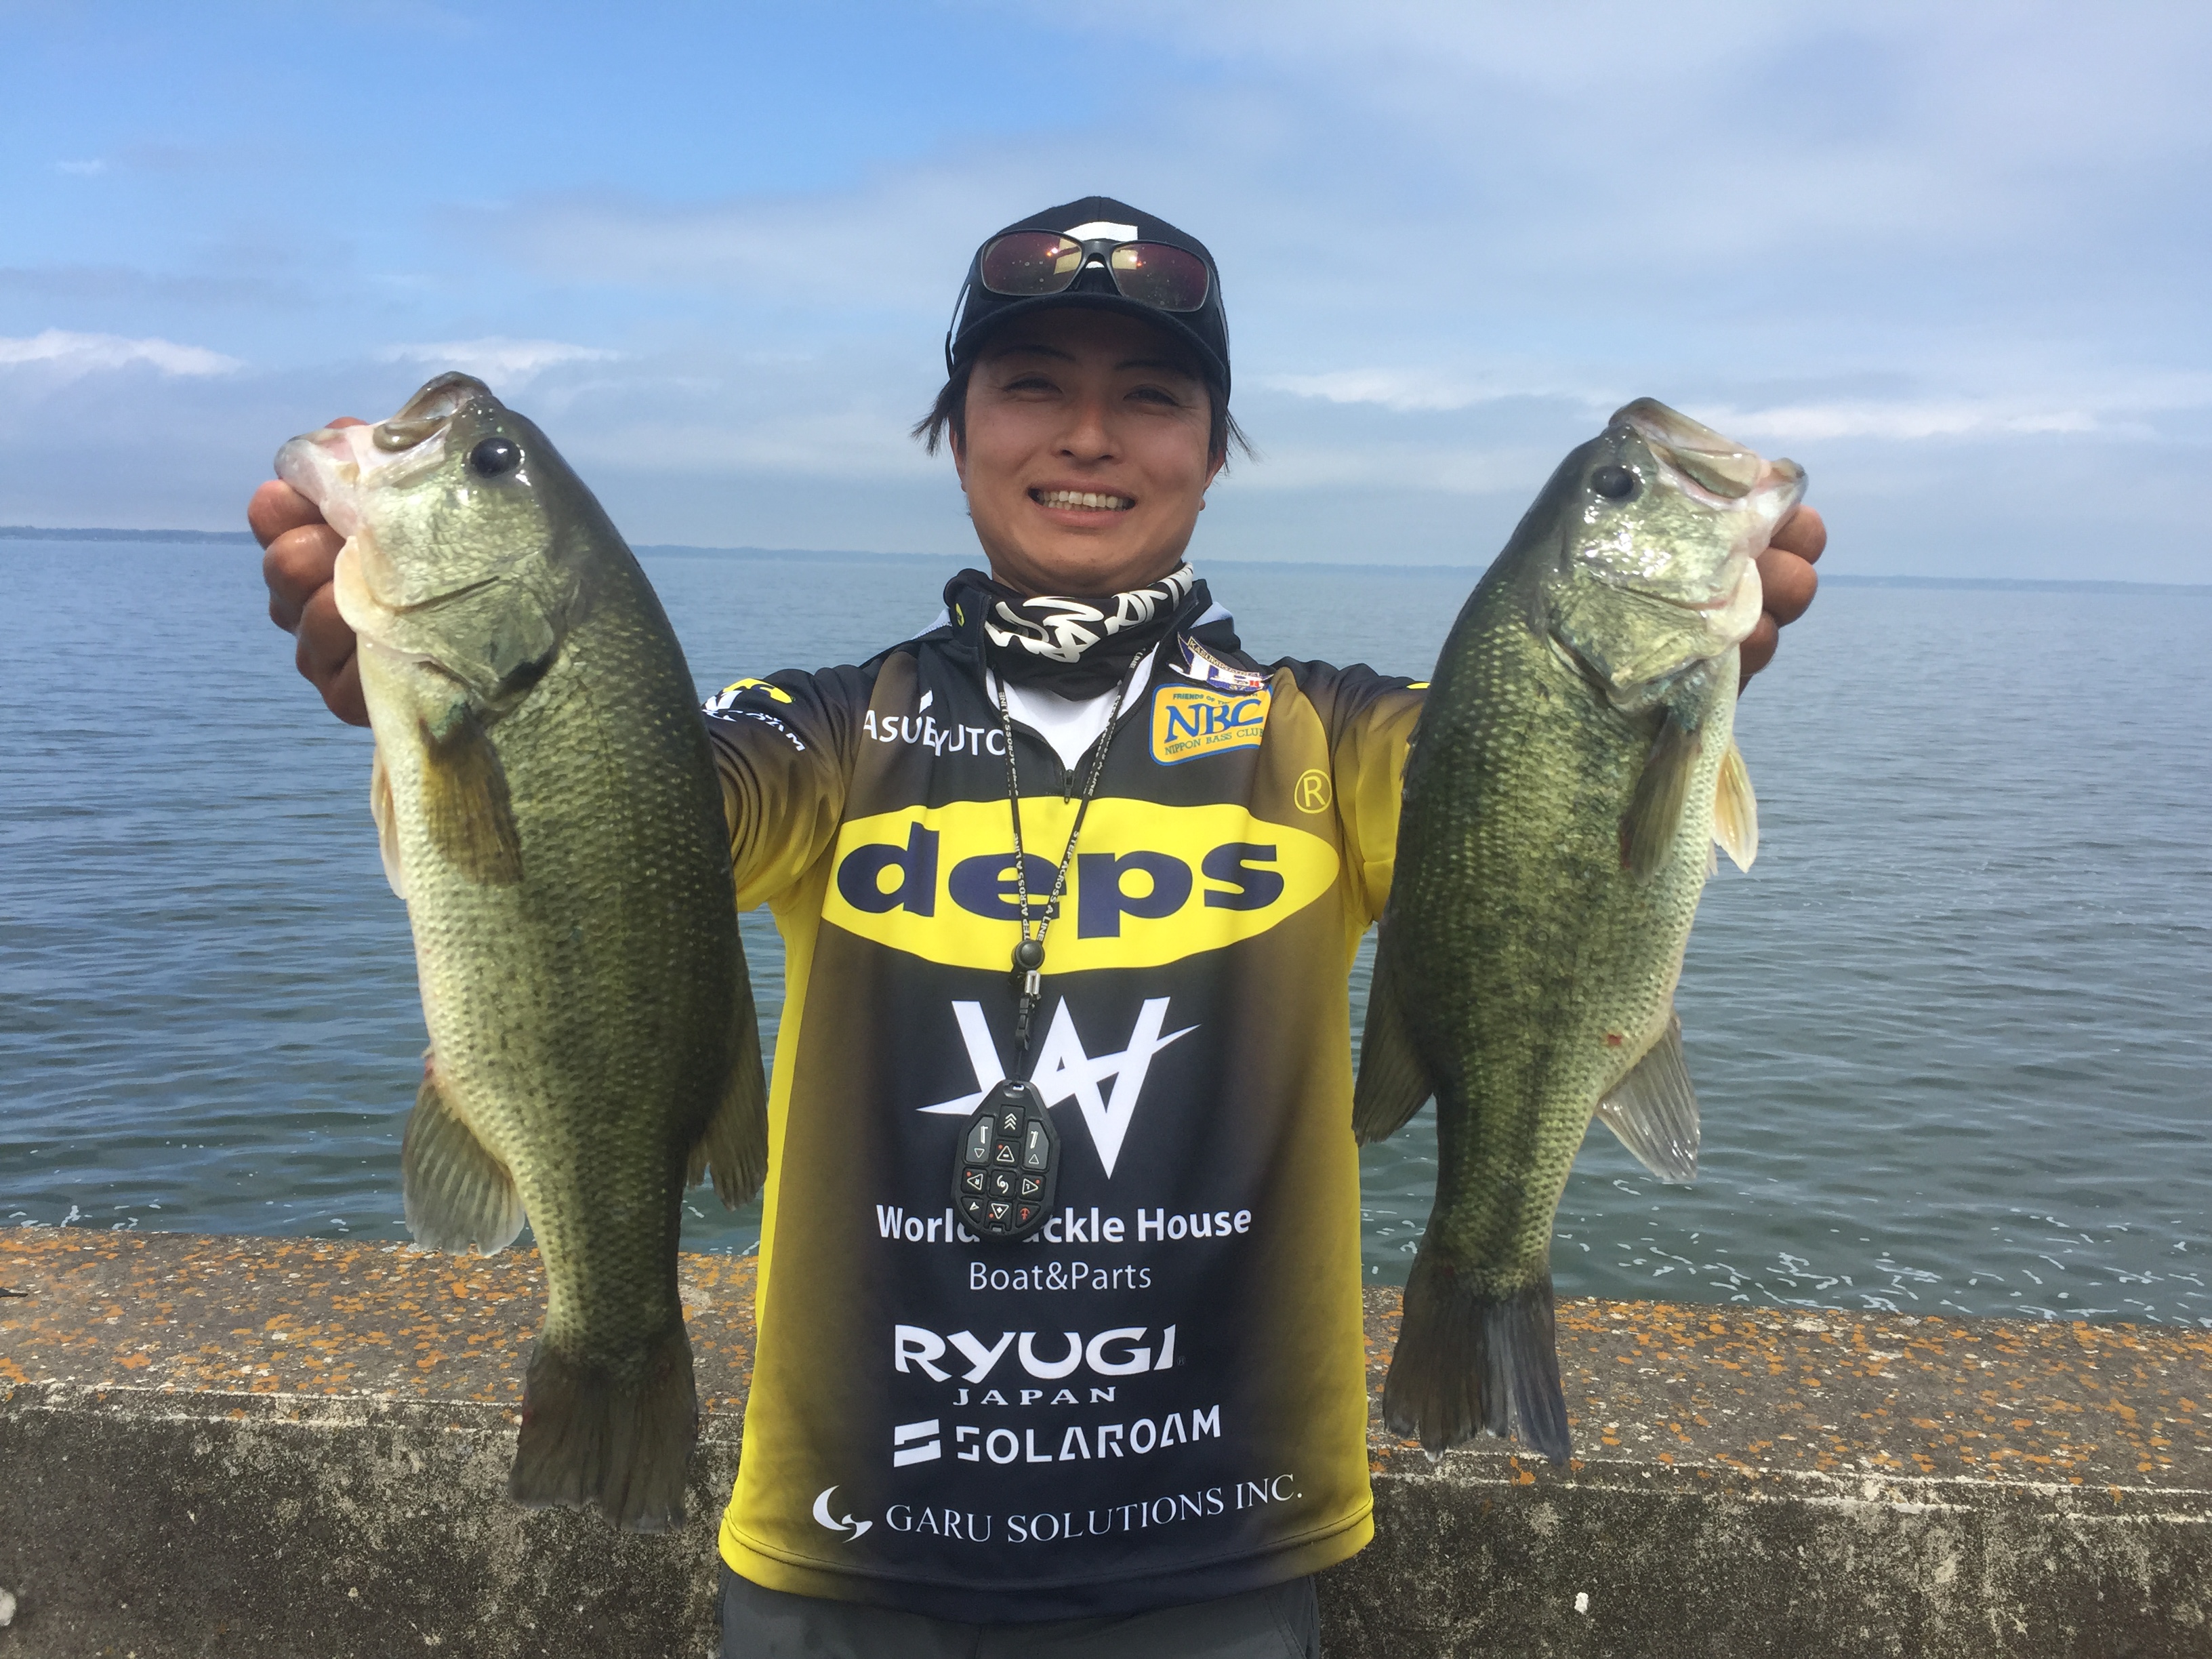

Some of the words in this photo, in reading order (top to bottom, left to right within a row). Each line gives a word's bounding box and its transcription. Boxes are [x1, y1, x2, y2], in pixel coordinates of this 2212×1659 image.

[998, 691, 1009, 712] LINE
[1206, 695, 1216, 703] OF
[1164, 699, 1264, 743] NBC
[1164, 738, 1202, 756] NIPPON
[1206, 732, 1232, 745] BASS
[1066, 830, 1080, 860] STEP
[837, 821, 1284, 939] deps
[1017, 872, 1029, 917] ACROSS
[1049, 860, 1069, 904] ACROSS
[1036, 916, 1052, 942] LINE
[1138, 1208, 1252, 1242] House
[970, 1261, 1151, 1290] Boat&Parts
[895, 1324, 1176, 1384] RYUGI
[952, 1386, 1116, 1406] JAPAN
[956, 1405, 1221, 1465] SOLAROAM
[886, 1504, 991, 1542] GARU
[1008, 1488, 1224, 1543] SOLUTIONS
[1235, 1473, 1303, 1511] INC.
